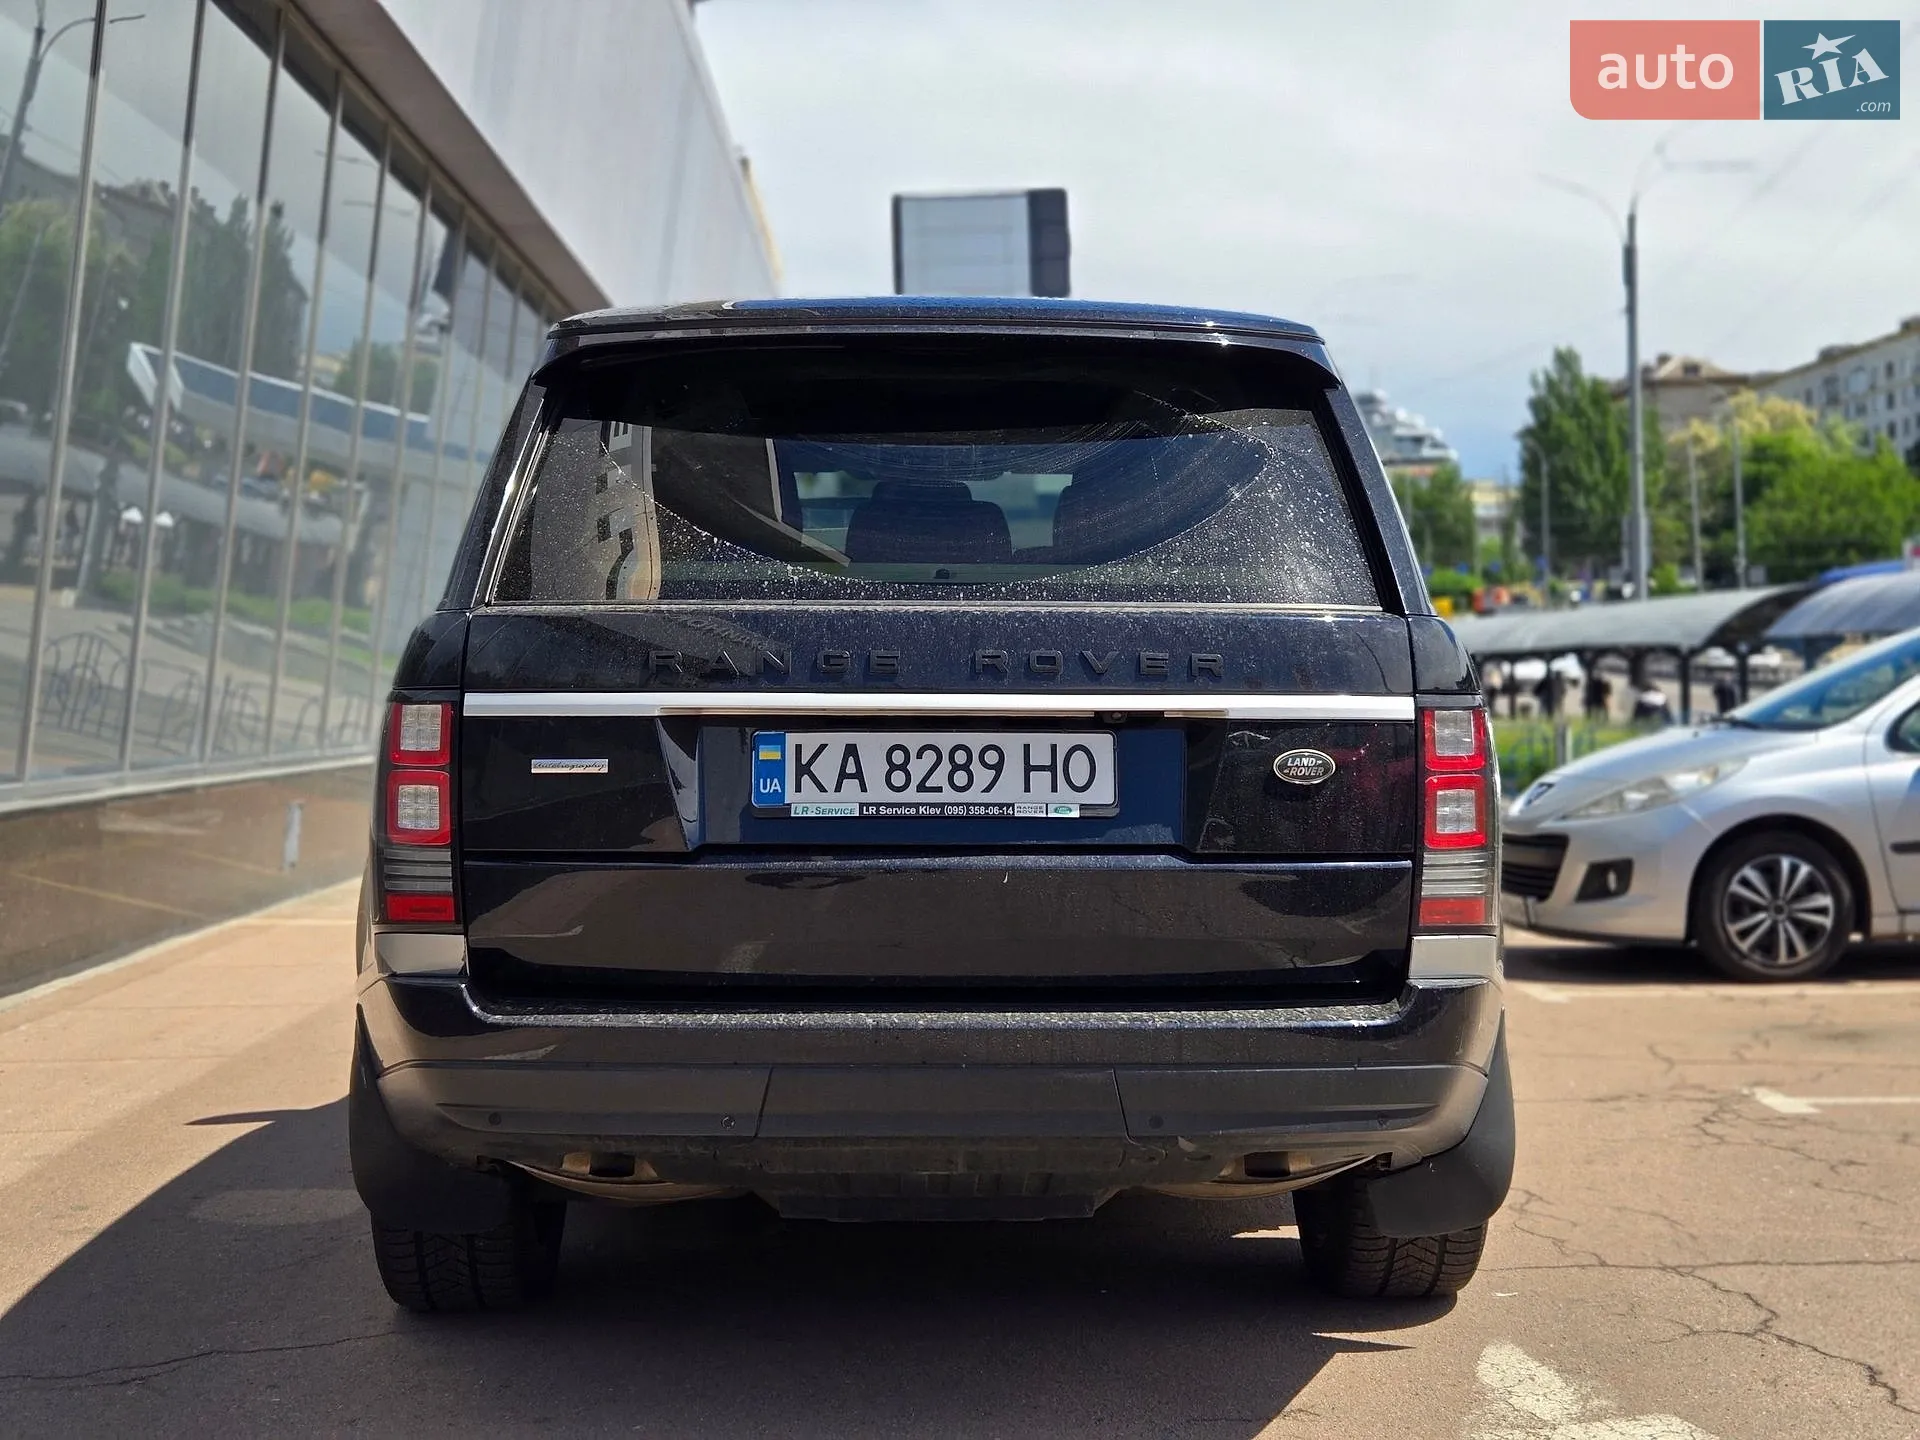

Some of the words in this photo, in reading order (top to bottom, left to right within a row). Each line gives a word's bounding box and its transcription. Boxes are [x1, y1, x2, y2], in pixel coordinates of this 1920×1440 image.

[651, 650, 899, 675] RANGE
[975, 650, 1225, 677] ROVER
[794, 743, 868, 793] KA
[884, 743, 1006, 793] 8289
[1023, 743, 1097, 793] HO
[1287, 757, 1315, 766] LAND
[1289, 767, 1324, 776] ROVER
[759, 777, 782, 794] UA
[862, 805, 877, 815] LR
[879, 805, 917, 815] Service
[918, 805, 942, 815] Kiev
[944, 804, 967, 816] (095)
[968, 804, 1014, 816] 358-06-14
